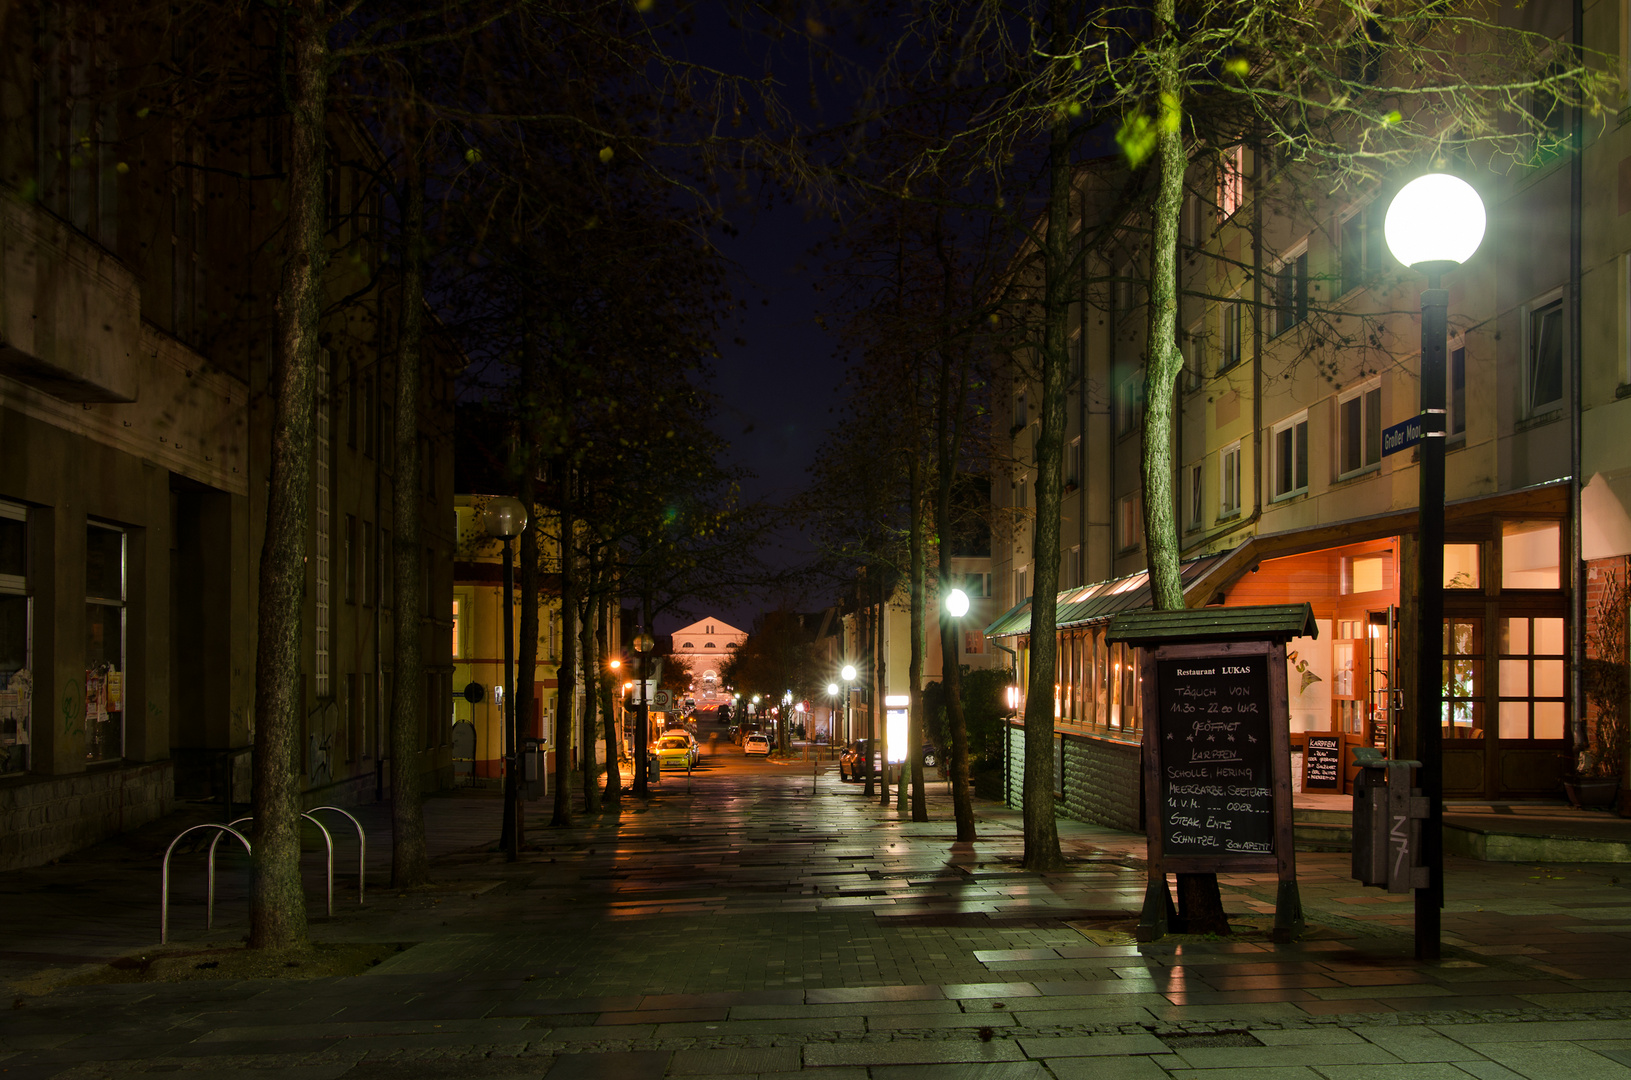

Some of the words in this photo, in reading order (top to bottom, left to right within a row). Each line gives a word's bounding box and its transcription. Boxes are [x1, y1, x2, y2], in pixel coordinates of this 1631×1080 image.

[1384, 430, 1404, 450] Großer
[1222, 666, 1251, 674] LUKAS
[1229, 686, 1250, 696] VON
[1170, 702, 1195, 713] 11.30
[1238, 702, 1258, 713] UHR
[1191, 748, 1237, 760] KARPFEN
[1167, 766, 1212, 779] SCHOLLE,
[1217, 767, 1252, 781] HERING
[1169, 812, 1200, 828] STEAK,
[1206, 816, 1232, 829] ENTE
[1171, 831, 1219, 847] SCHNITZEL
